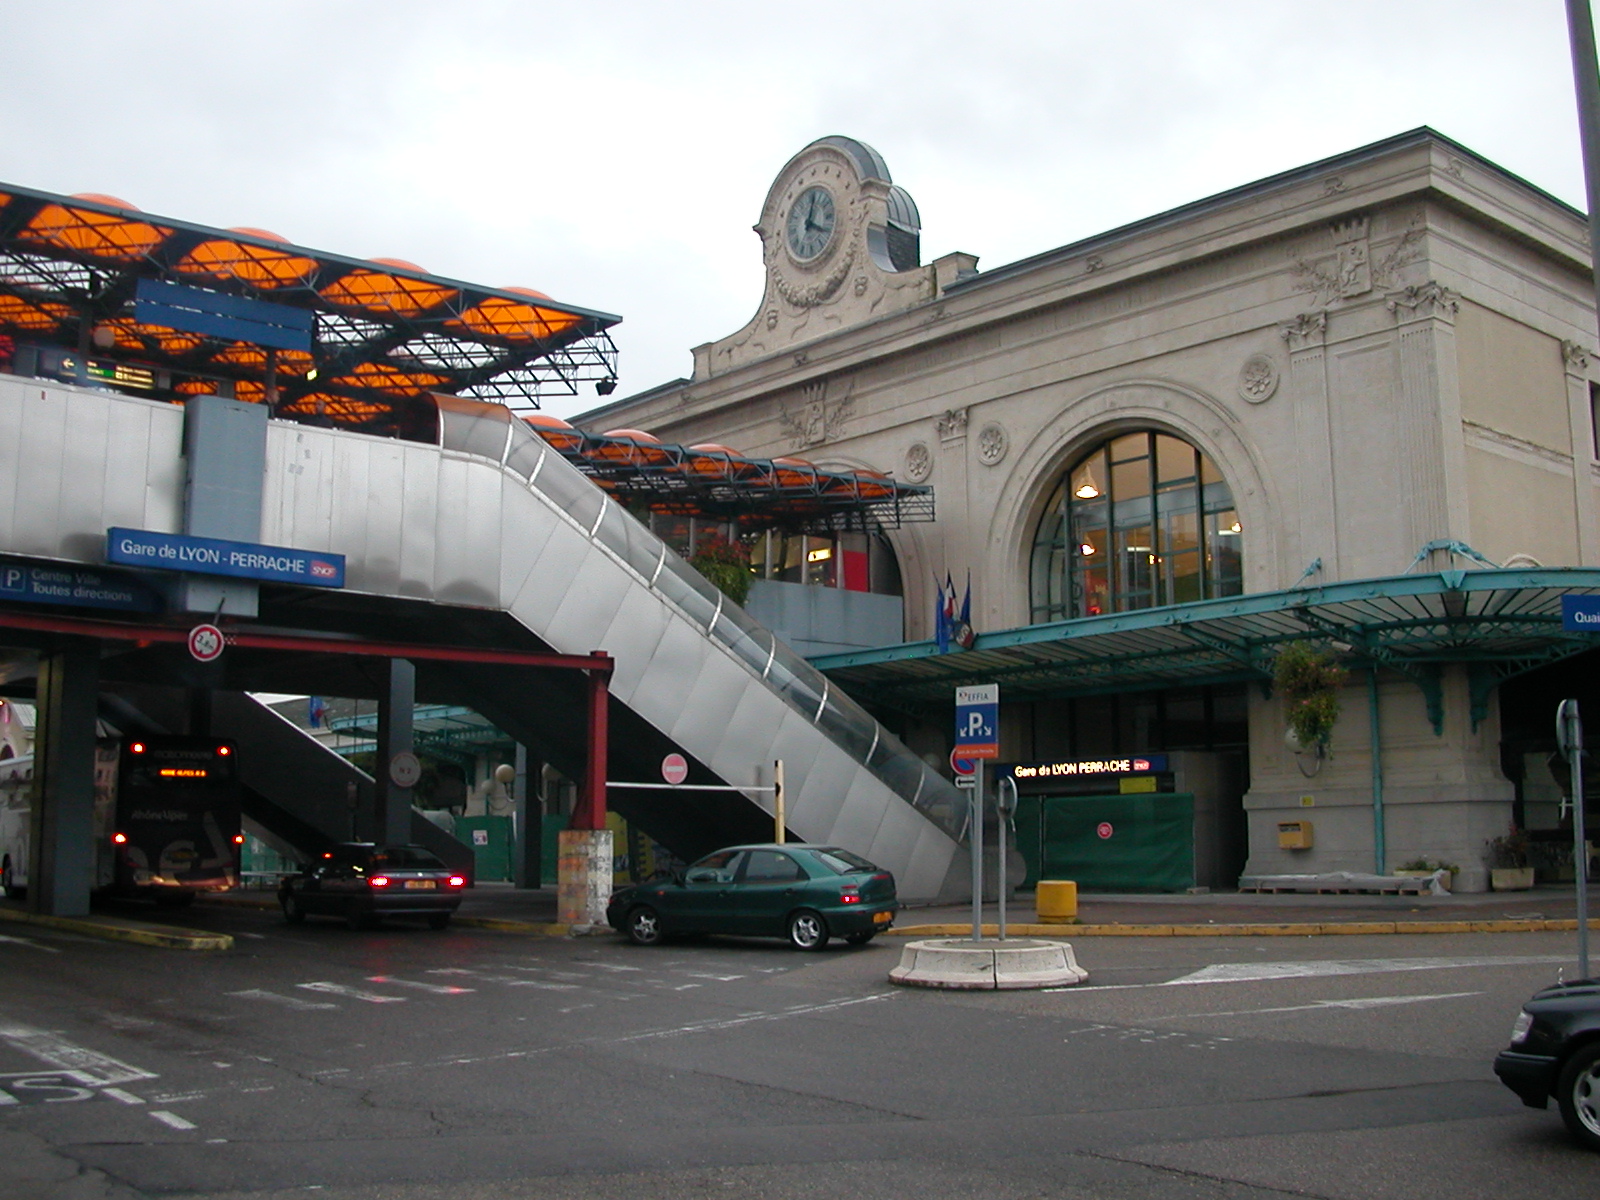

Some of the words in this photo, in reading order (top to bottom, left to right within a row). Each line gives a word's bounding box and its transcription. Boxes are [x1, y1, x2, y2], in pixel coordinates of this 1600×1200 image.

[121, 539, 156, 557] Gare
[159, 544, 177, 559] de
[179, 545, 220, 564] LYON
[230, 551, 305, 574] PERRACHE
[311, 565, 337, 577] SNCF
[6, 569, 21, 587] P
[31, 568, 72, 583] Centre
[75, 572, 101, 586] Ville
[32, 581, 71, 597] Toutes
[73, 585, 133, 602] directions
[968, 692, 989, 702] EFFIA
[969, 712, 983, 737] P
[1014, 765, 1037, 778] Gare
[1039, 764, 1051, 777] de
[1052, 762, 1077, 776] LYON
[1078, 759, 1130, 774] PERRACHE
